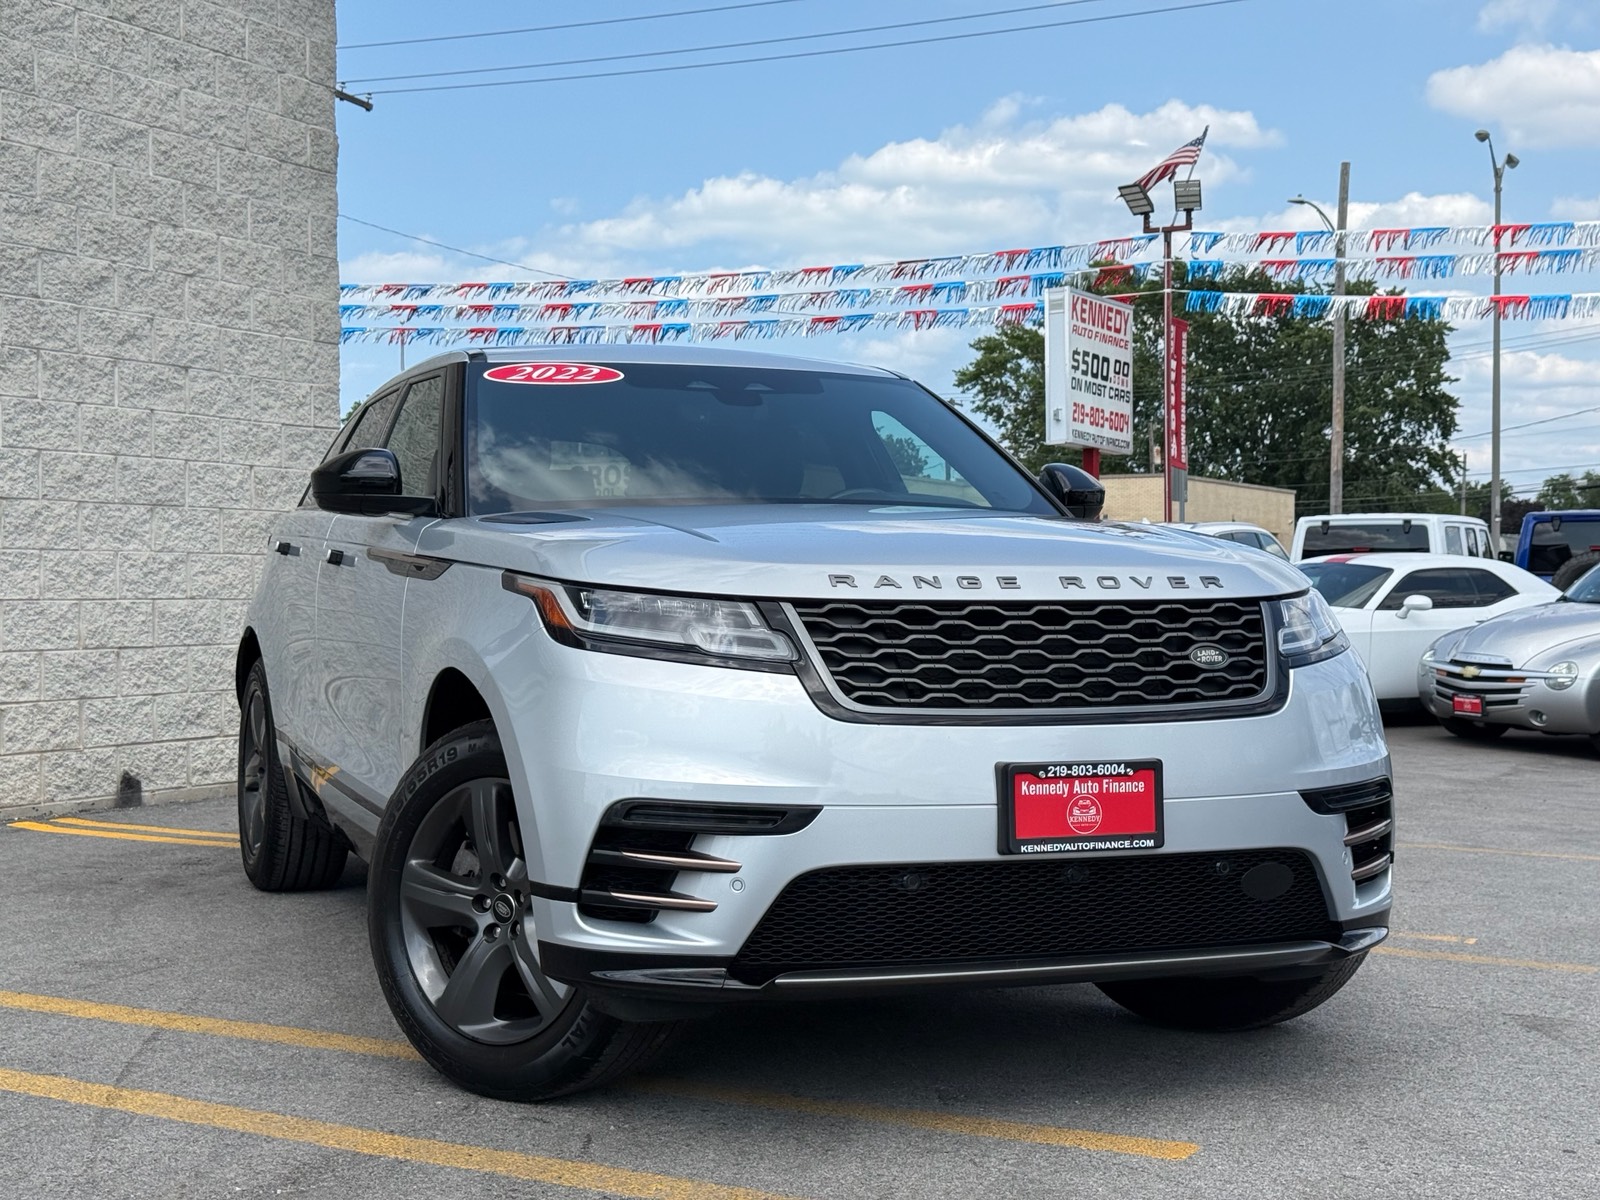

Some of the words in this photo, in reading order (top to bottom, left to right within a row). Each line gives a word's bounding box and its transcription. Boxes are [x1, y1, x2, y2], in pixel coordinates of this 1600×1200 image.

[1072, 295, 1130, 336] KENNEDY
[1072, 324, 1094, 340] AUTO
[1094, 331, 1130, 351] FINANCE
[506, 366, 600, 380] 2022
[1071, 377, 1083, 392] ON
[1084, 380, 1107, 398] MOST
[1108, 387, 1131, 404] CARS
[1072, 402, 1130, 435] 219-803-6004
[1072, 429, 1131, 450] KENNEDYAUTOFNANCE.COM
[828, 574, 1021, 590] RANGE
[1058, 575, 1224, 590] ROVER
[1201, 655, 1223, 663] ROVER
[1047, 763, 1126, 777] 219-803-6004
[1021, 780, 1069, 798] Kennedy
[1073, 779, 1099, 795] Auto
[1102, 778, 1145, 794] Finance
[1068, 815, 1101, 823] KENNEDY
[1021, 840, 1155, 853] KENNEDYAUTOFINANCE.COM
